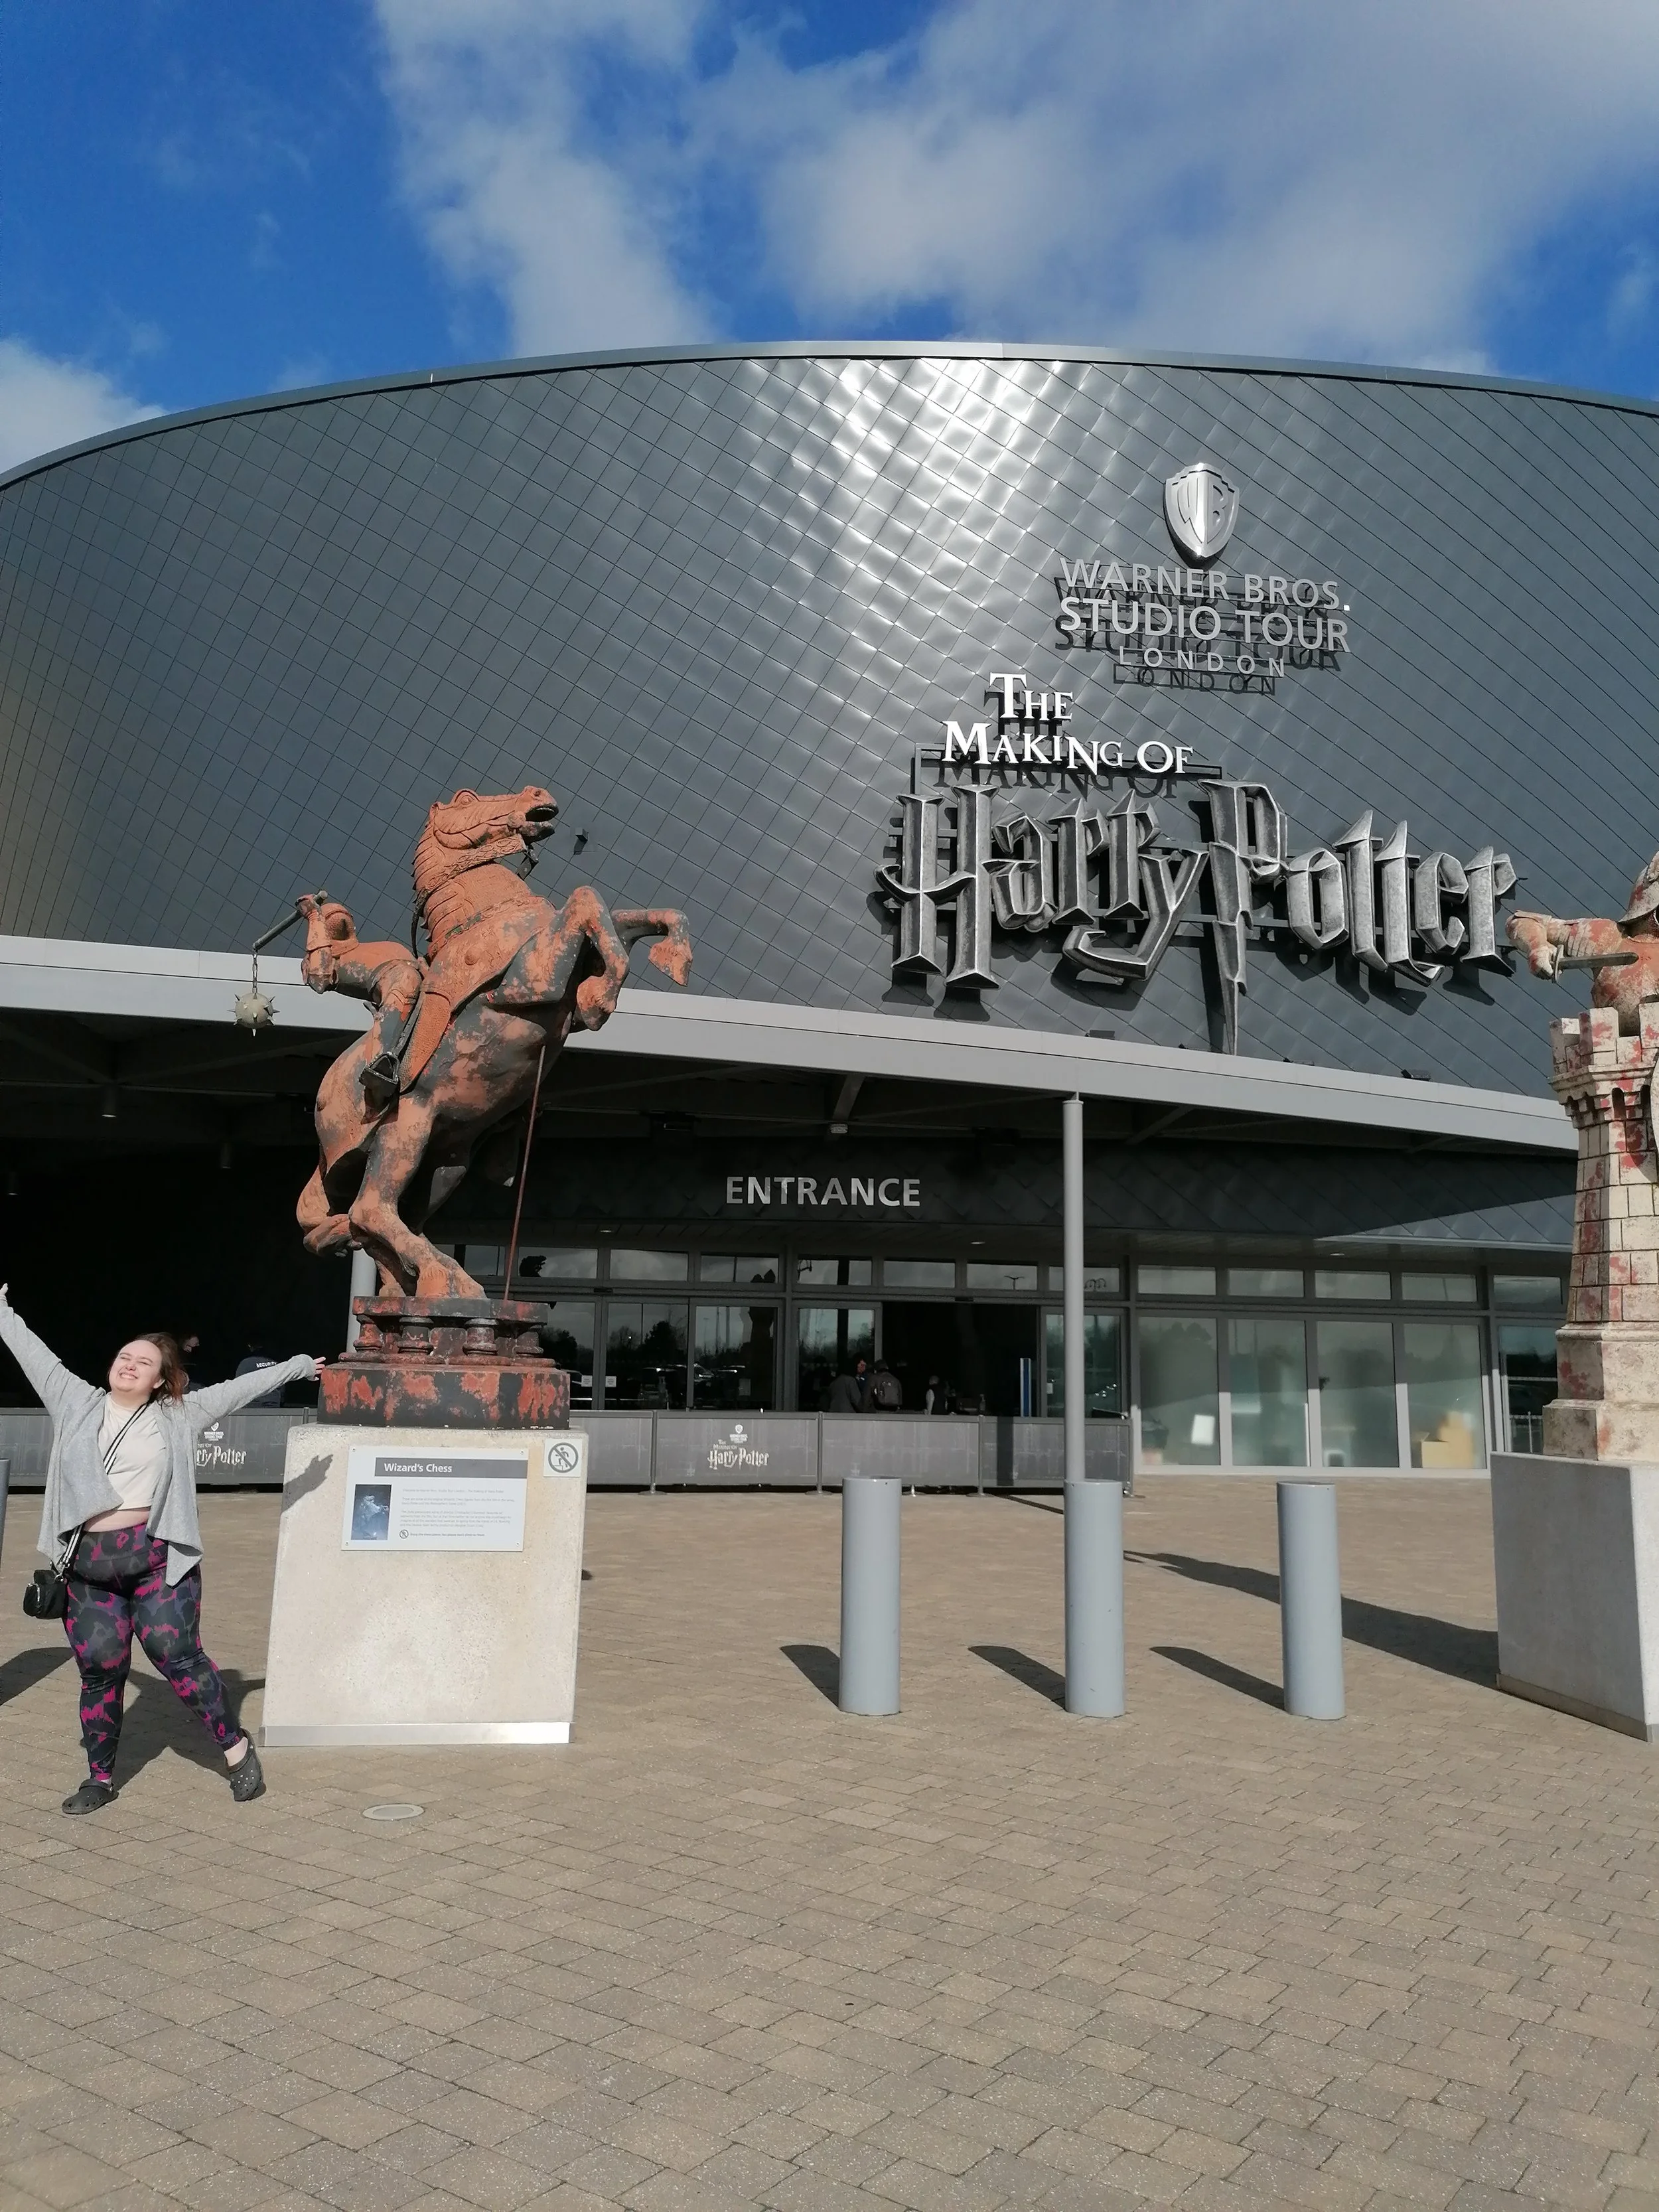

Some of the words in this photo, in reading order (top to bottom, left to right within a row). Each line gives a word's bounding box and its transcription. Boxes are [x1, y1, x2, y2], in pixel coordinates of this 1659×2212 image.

[1177, 475, 1229, 544] WB
[1060, 557, 1230, 600] WARNER
[1244, 573, 1350, 611] BROS.
[1060, 597, 1222, 640] STUDIO
[1235, 609, 1351, 653] TOUR
[1119, 646, 1285, 678] LONDON
[1136, 740, 1194, 774] OF
[873, 783, 1208, 990] Harry
[1196, 778, 1518, 1057] Potter
[726, 1176, 921, 1207] ENTRANCE
[196, 1449, 212, 1467] rry
[213, 1445, 247, 1470] Potter
[384, 1463, 423, 1473] Wizard's
[425, 1463, 453, 1473] Chess
[707, 1449, 739, 1470] Harry
[739, 1447, 770, 1470] Potter
